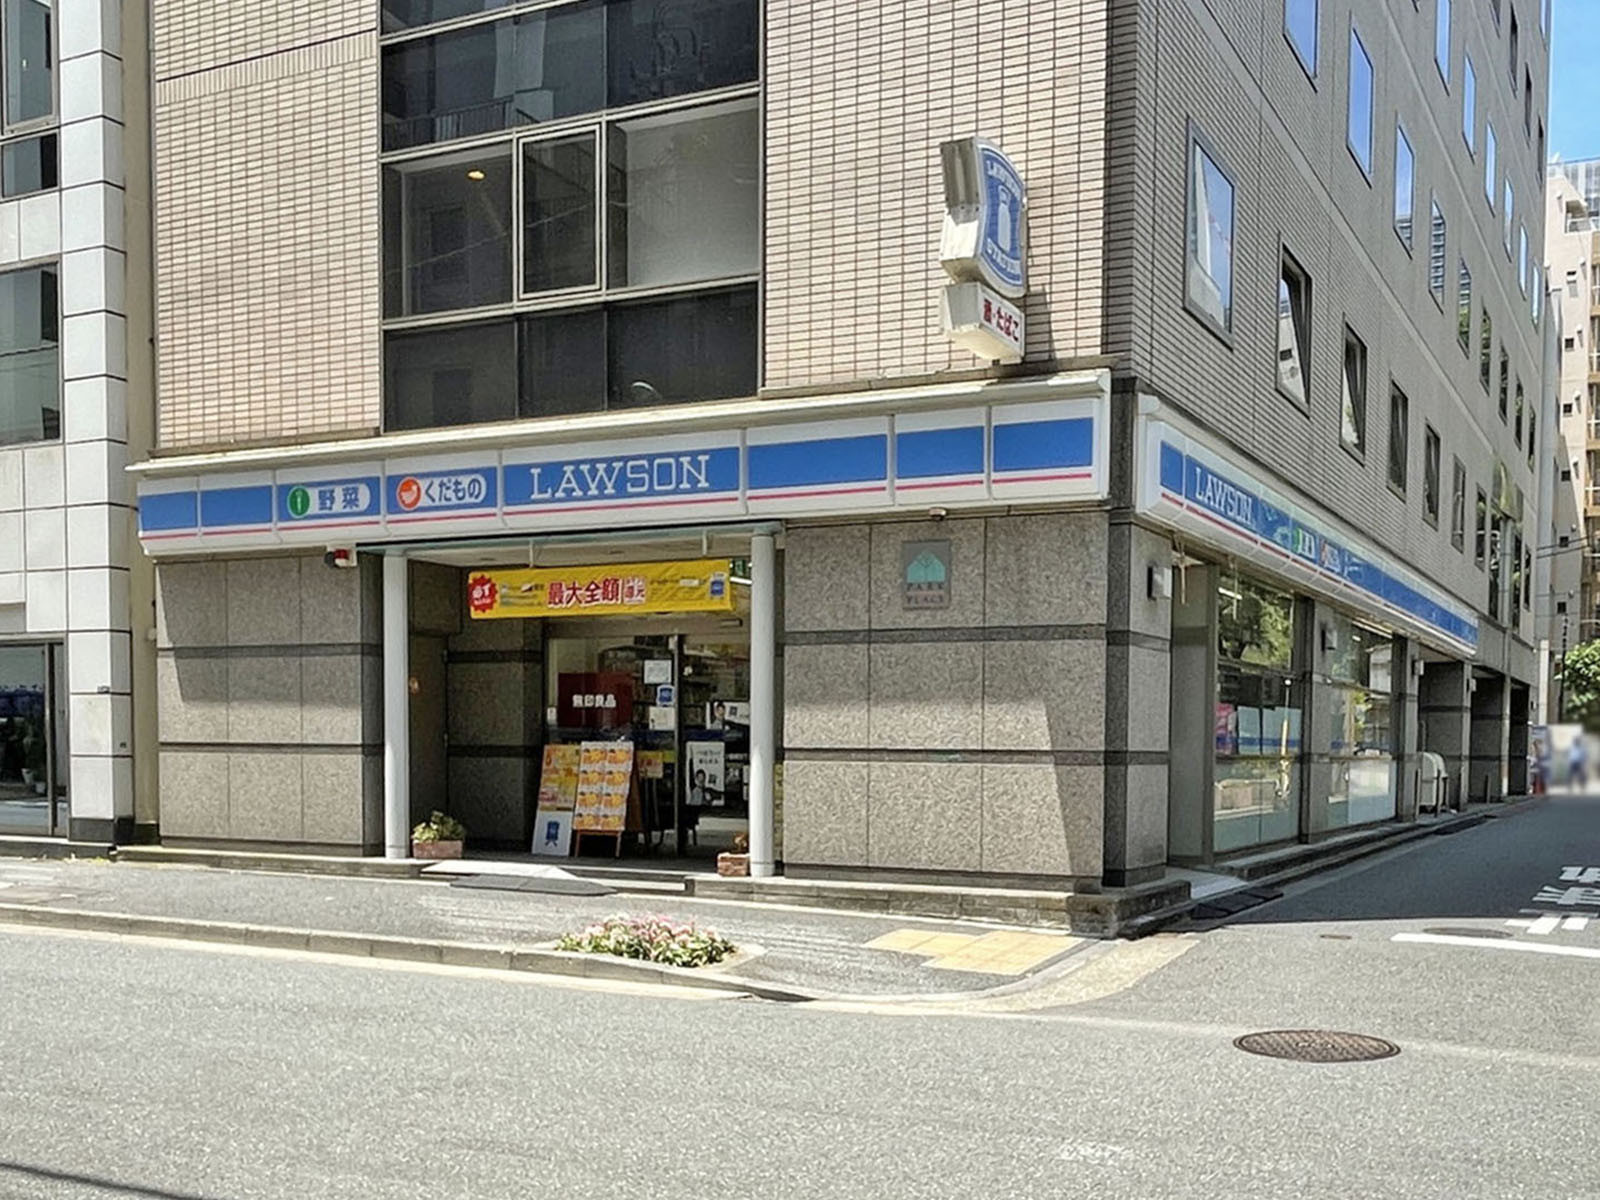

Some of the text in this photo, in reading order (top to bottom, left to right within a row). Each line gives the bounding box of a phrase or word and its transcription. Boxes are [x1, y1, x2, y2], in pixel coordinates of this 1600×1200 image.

[425, 478, 482, 503] くだもの
[530, 455, 710, 499] LAWSON
[318, 486, 359, 511] 野菜
[1195, 467, 1253, 525] LAWSON
